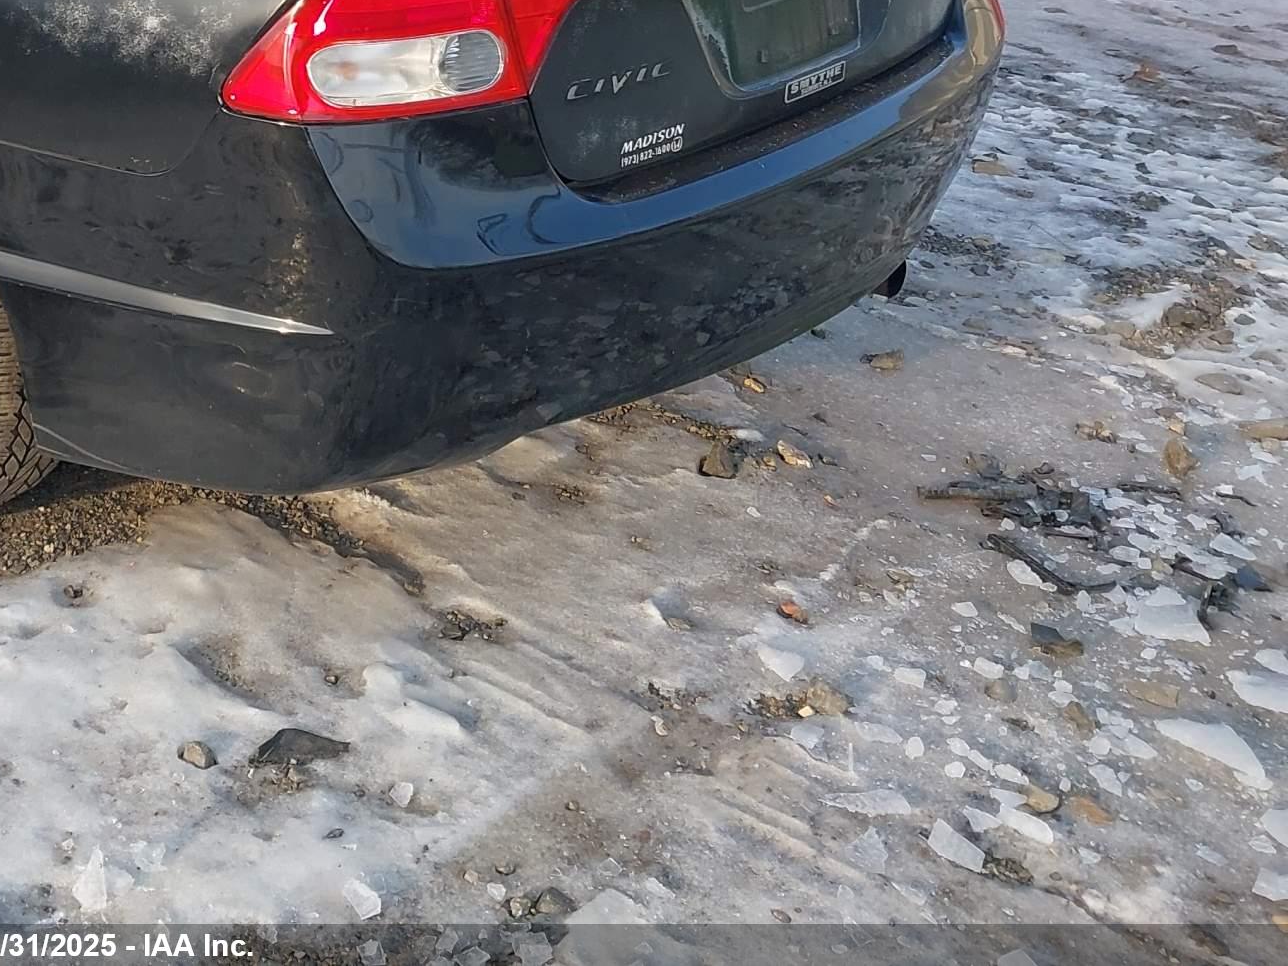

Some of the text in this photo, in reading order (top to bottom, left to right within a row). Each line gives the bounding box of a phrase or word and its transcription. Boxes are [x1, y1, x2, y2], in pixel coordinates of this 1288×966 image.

[567, 63, 671, 100] CIVIC
[791, 65, 843, 94] SMYTHE
[621, 123, 685, 154] MADISON
[620, 154, 639, 168] (973)
